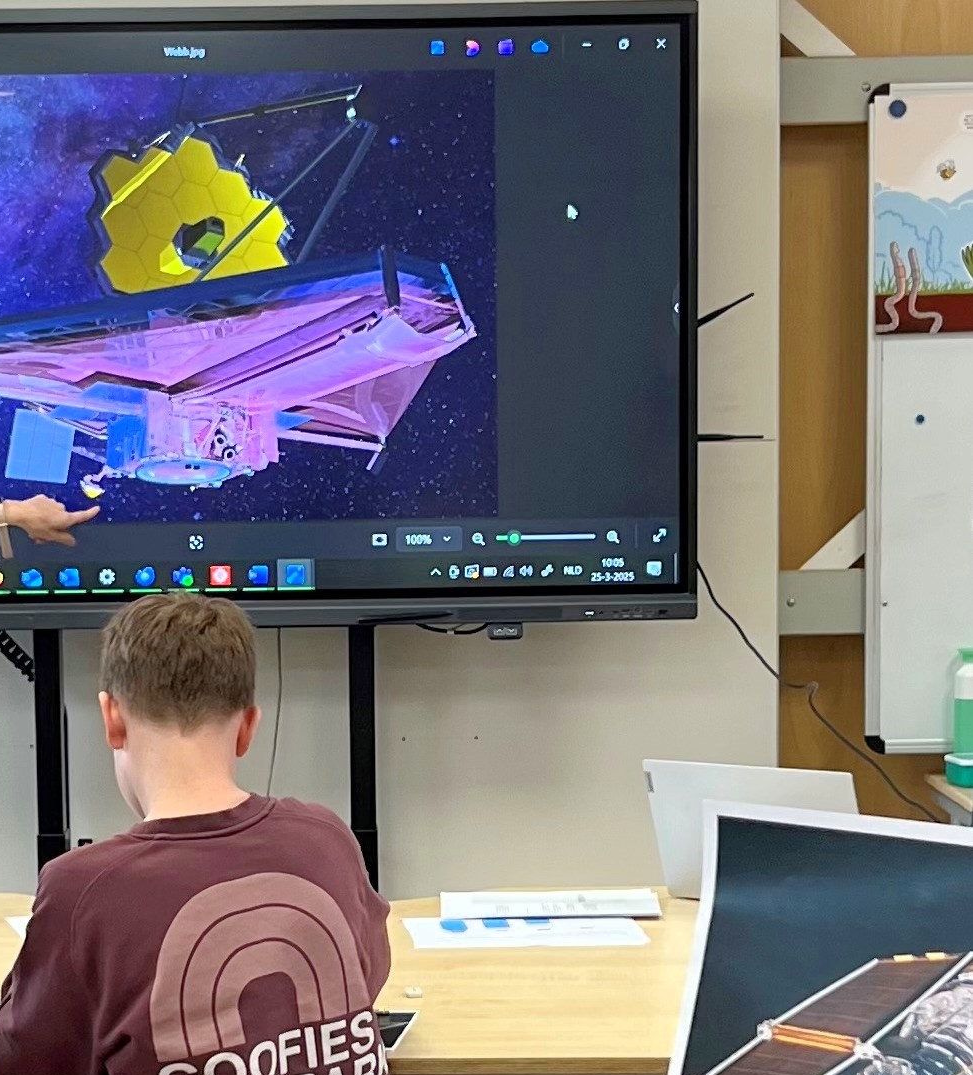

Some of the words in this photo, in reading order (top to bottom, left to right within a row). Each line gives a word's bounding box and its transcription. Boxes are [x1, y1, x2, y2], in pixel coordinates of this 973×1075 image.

[405, 534, 432, 545] 100%
[563, 565, 583, 576] NLD
[590, 571, 635, 582] 25-3-2025
